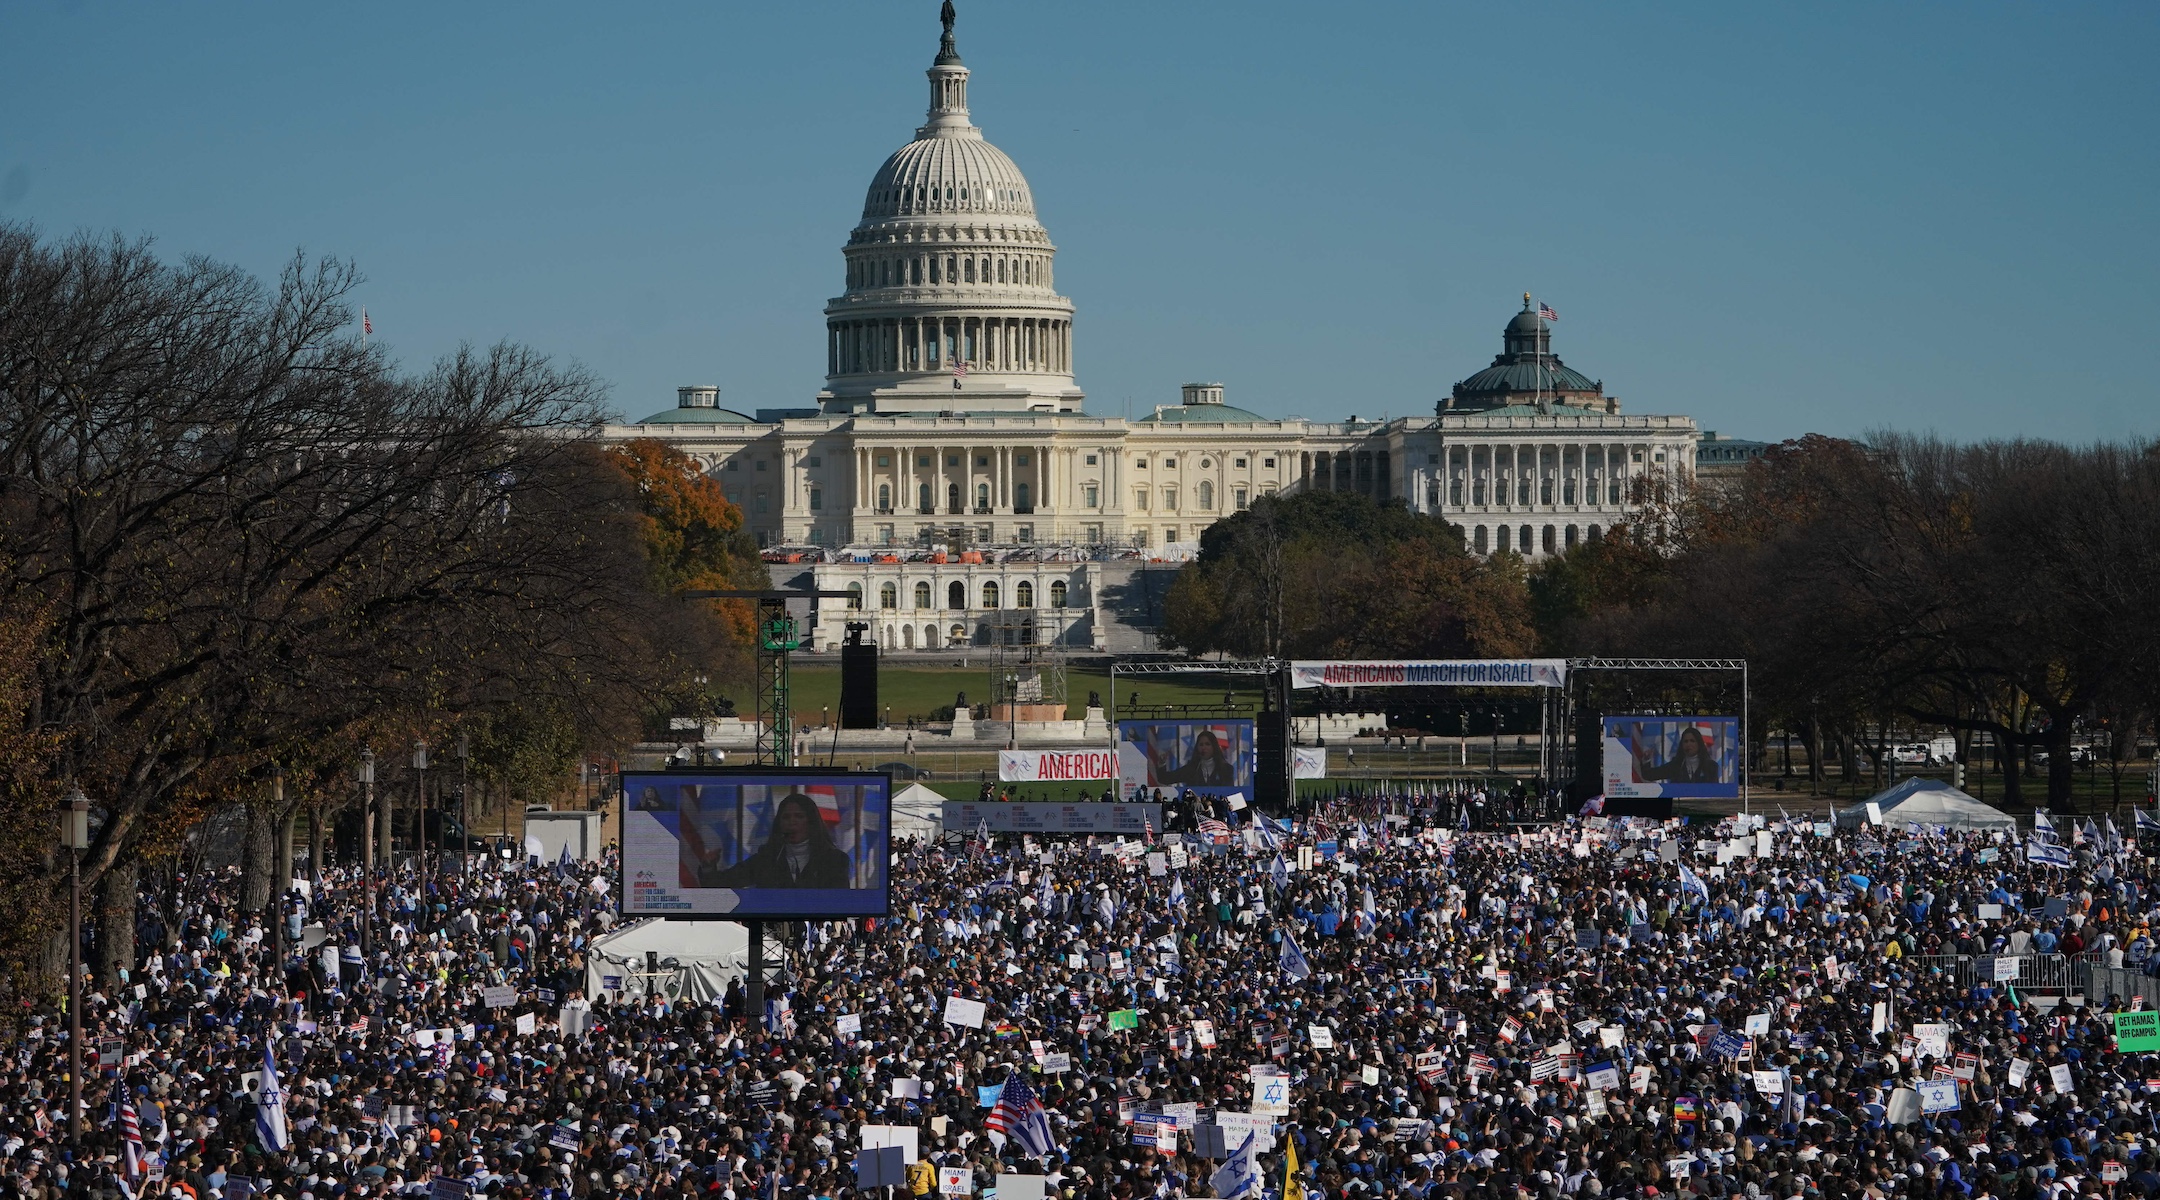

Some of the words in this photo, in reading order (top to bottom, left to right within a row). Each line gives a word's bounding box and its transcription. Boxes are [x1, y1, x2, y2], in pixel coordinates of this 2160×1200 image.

[1323, 663, 1404, 684] AMERICANS
[1407, 664, 1458, 682] MARCH
[1460, 664, 1486, 682] FOR
[1488, 662, 1534, 682] ISRAEL
[1038, 753, 1120, 779] AMERICAN
[2118, 1016, 2130, 1027] GET
[2132, 1015, 2155, 1025] HAMAS
[1914, 1028, 1946, 1037] HAMAS
[2120, 1029, 2131, 1039] OFF
[2132, 1027, 2157, 1038] CAMPUS
[1713, 1044, 1735, 1059] ISRAEL
[914, 1171, 922, 1184] 7
